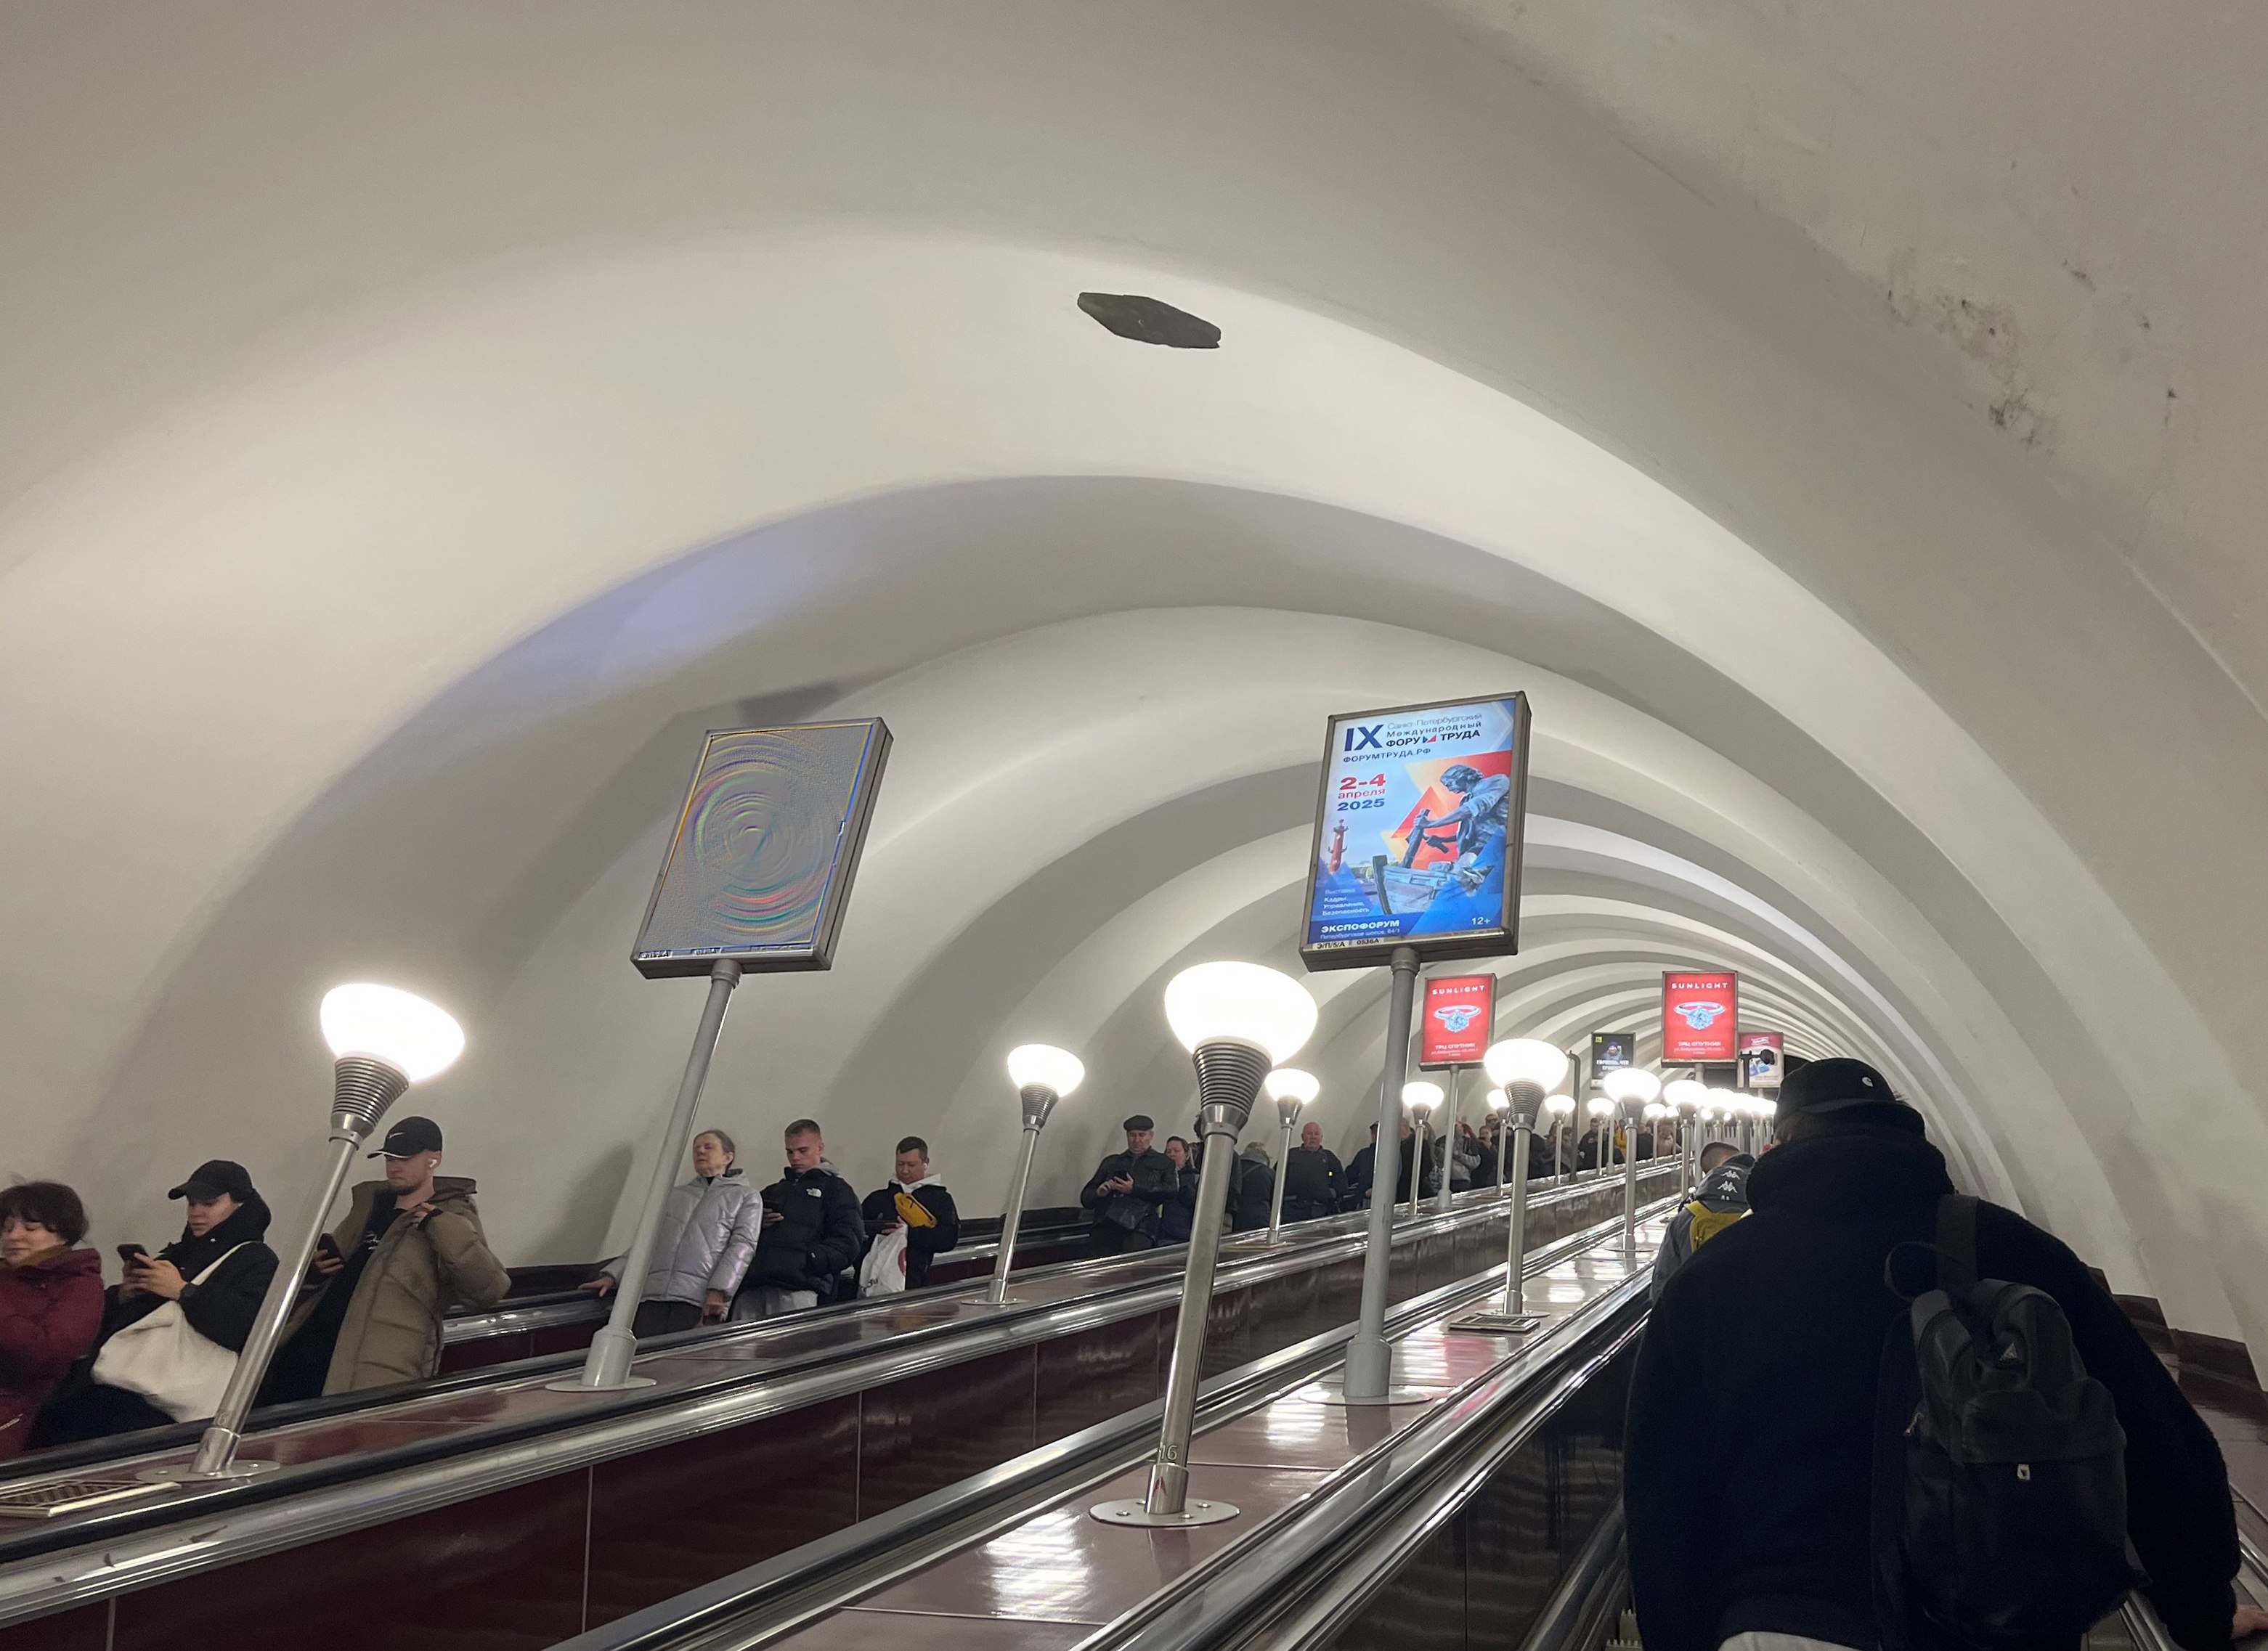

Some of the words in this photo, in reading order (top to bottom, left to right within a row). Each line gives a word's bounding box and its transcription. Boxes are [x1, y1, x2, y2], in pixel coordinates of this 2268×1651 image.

[1386, 721, 1482, 738] Международный
[1439, 729, 1481, 741] ТРУДА
[1344, 724, 1385, 752] IX
[1343, 747, 1431, 763] ФОРУМТРУДА.РФ
[1339, 772, 1386, 791] 2-4
[1338, 788, 1386, 799] апреля
[1337, 798, 1385, 812] 2025
[1322, 907, 1370, 916] Безопасность
[1321, 919, 1400, 934] ЭКСПОФОРУМ
[1471, 916, 1491, 926] 12+
[1432, 985, 1485, 995] SUNLIGHT
